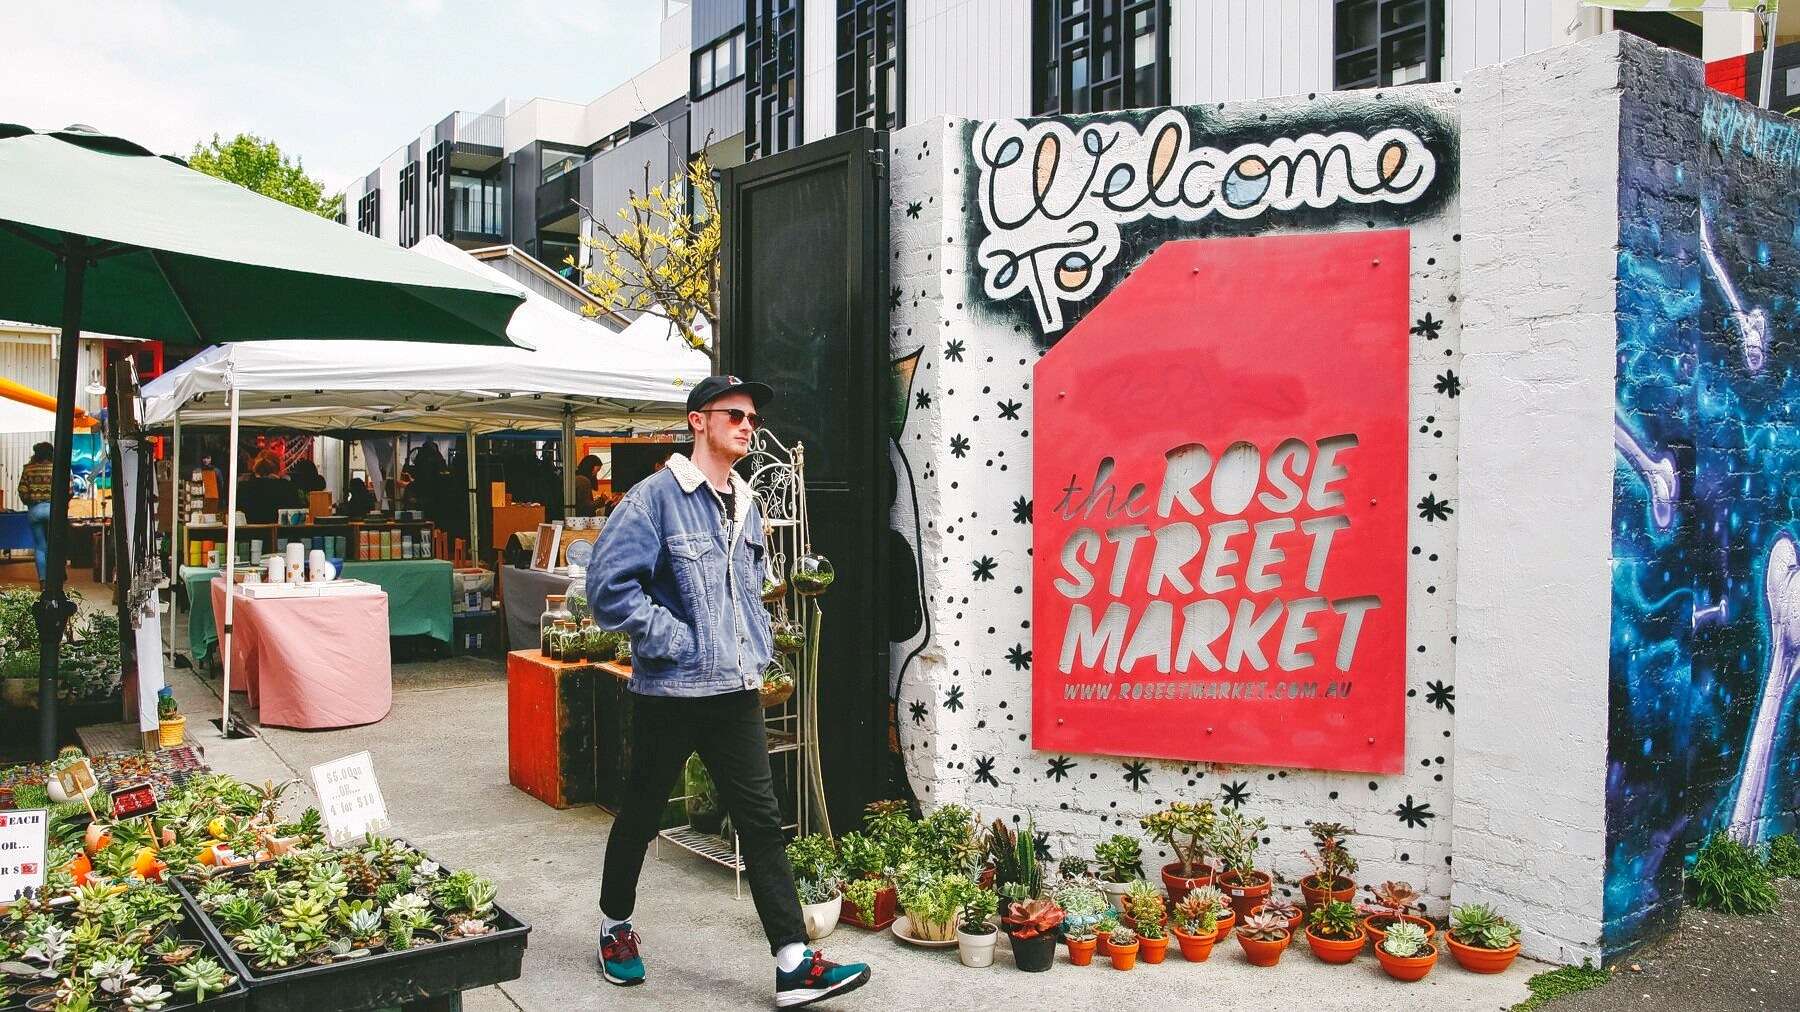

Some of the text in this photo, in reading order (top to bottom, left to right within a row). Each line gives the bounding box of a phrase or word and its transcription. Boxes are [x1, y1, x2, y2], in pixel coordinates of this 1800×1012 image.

[982, 122, 1424, 230] Welcome
[986, 221, 1102, 325] To
[1054, 432, 1360, 520] the ROSE
[1053, 514, 1353, 599] STREET
[1058, 594, 1382, 674] MARKET
[9, 815, 40, 826] EACH
